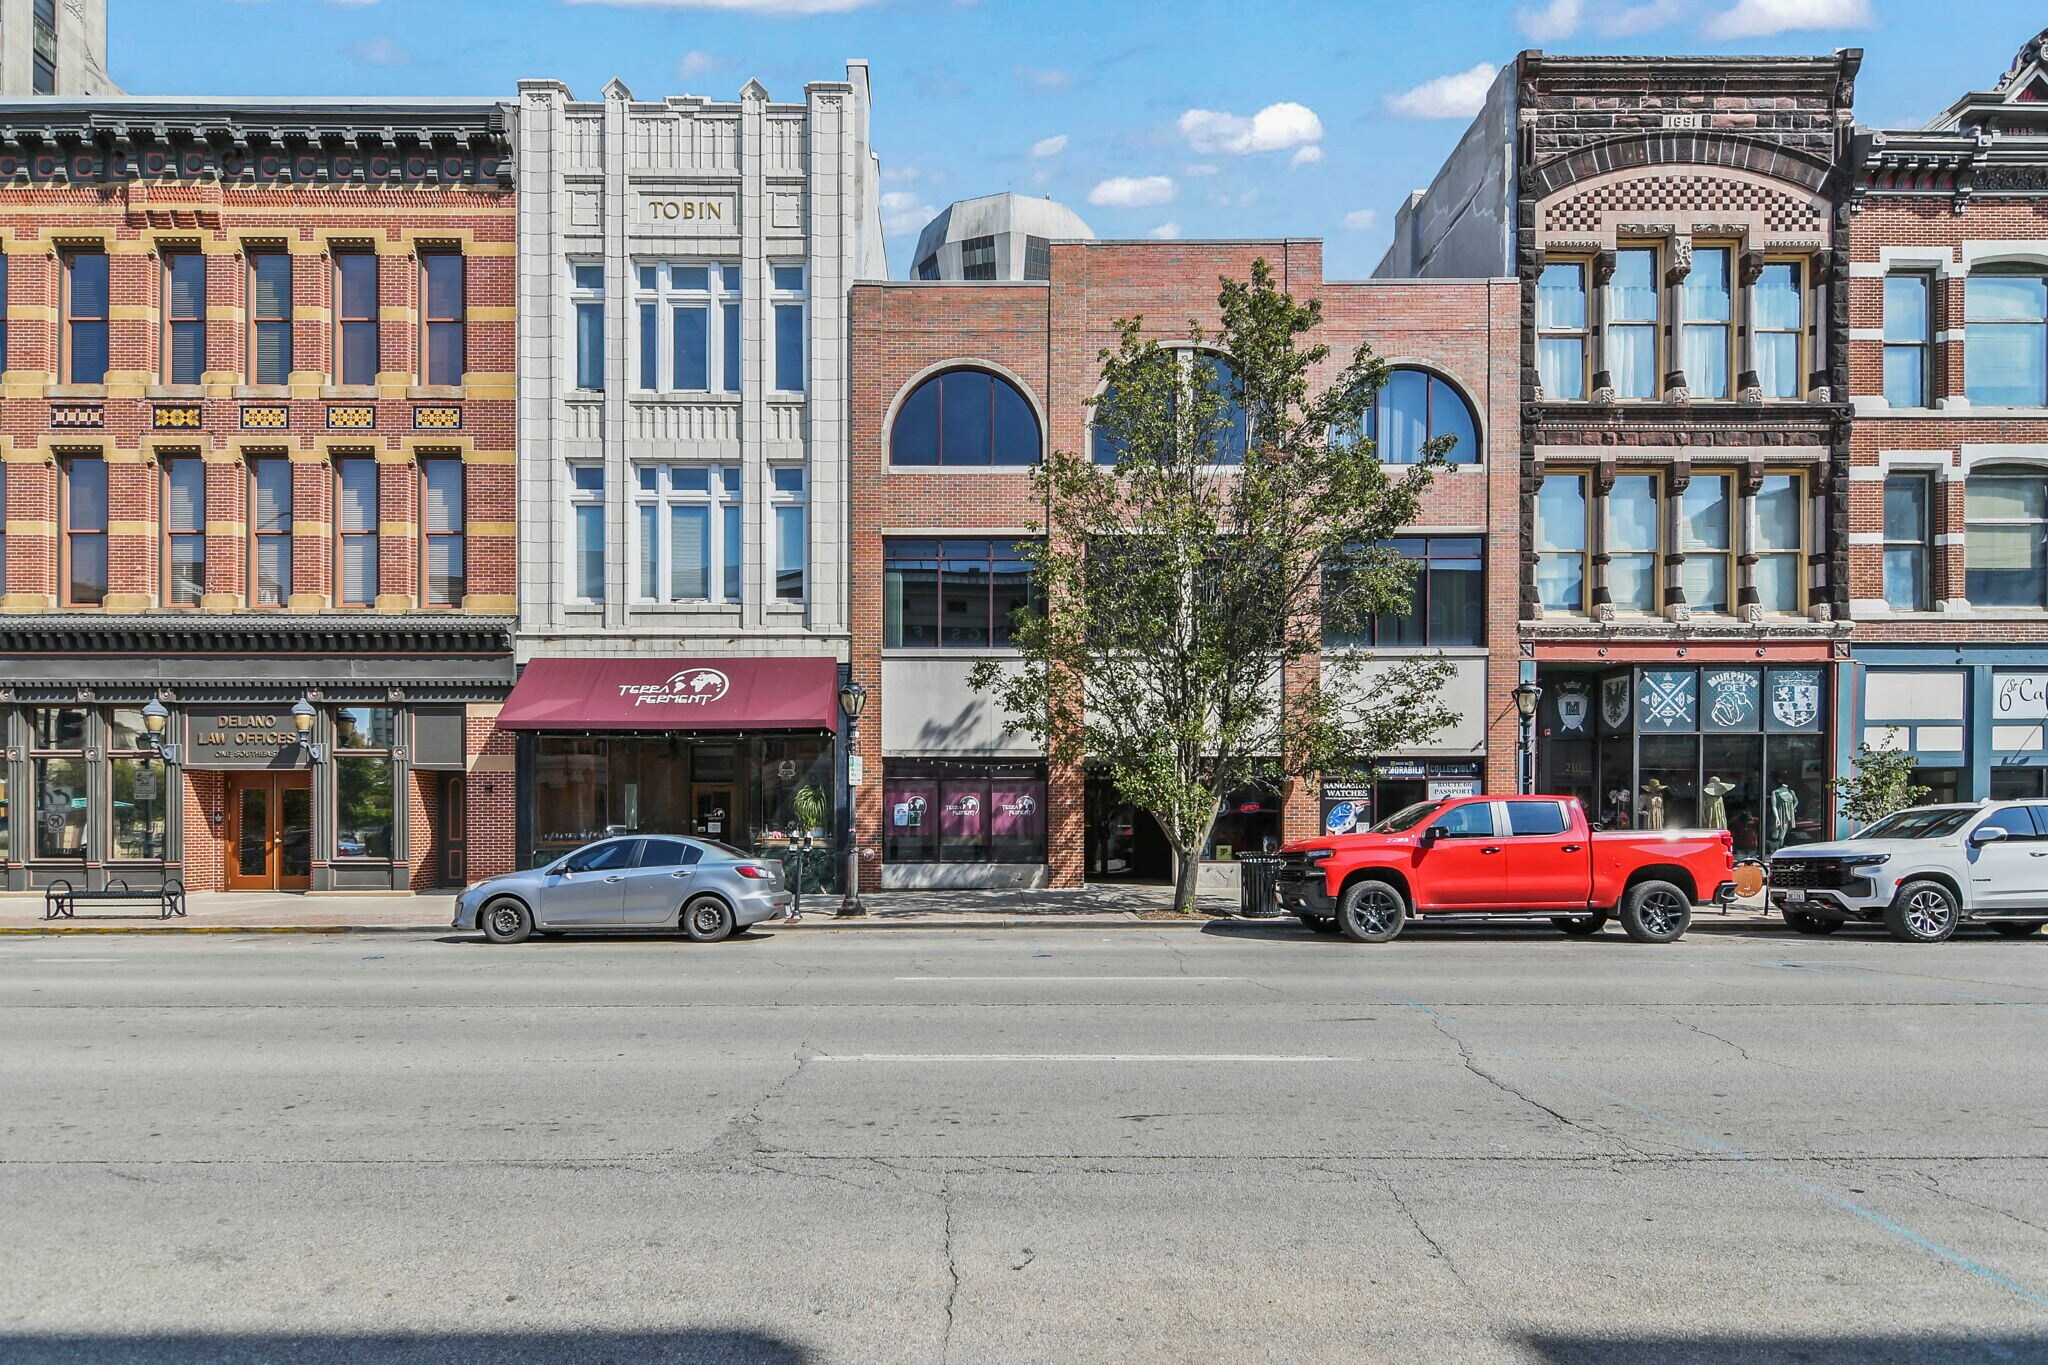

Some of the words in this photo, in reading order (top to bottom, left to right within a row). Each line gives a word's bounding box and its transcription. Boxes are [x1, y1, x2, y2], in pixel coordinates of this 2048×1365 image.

[648, 201, 722, 220] TOBIN
[1707, 671, 1759, 688] MURPHY'S
[618, 684, 670, 697] TERRA
[1717, 683, 1750, 693] LOFT
[634, 694, 723, 707] FERMENT
[217, 714, 277, 729] DELANO
[197, 732, 228, 746] LAW
[234, 731, 298, 746] OFFICES
[214, 750, 231, 759] ONE
[234, 749, 279, 759] SOUTHEAST
[1326, 789, 1368, 798] WATCHES
